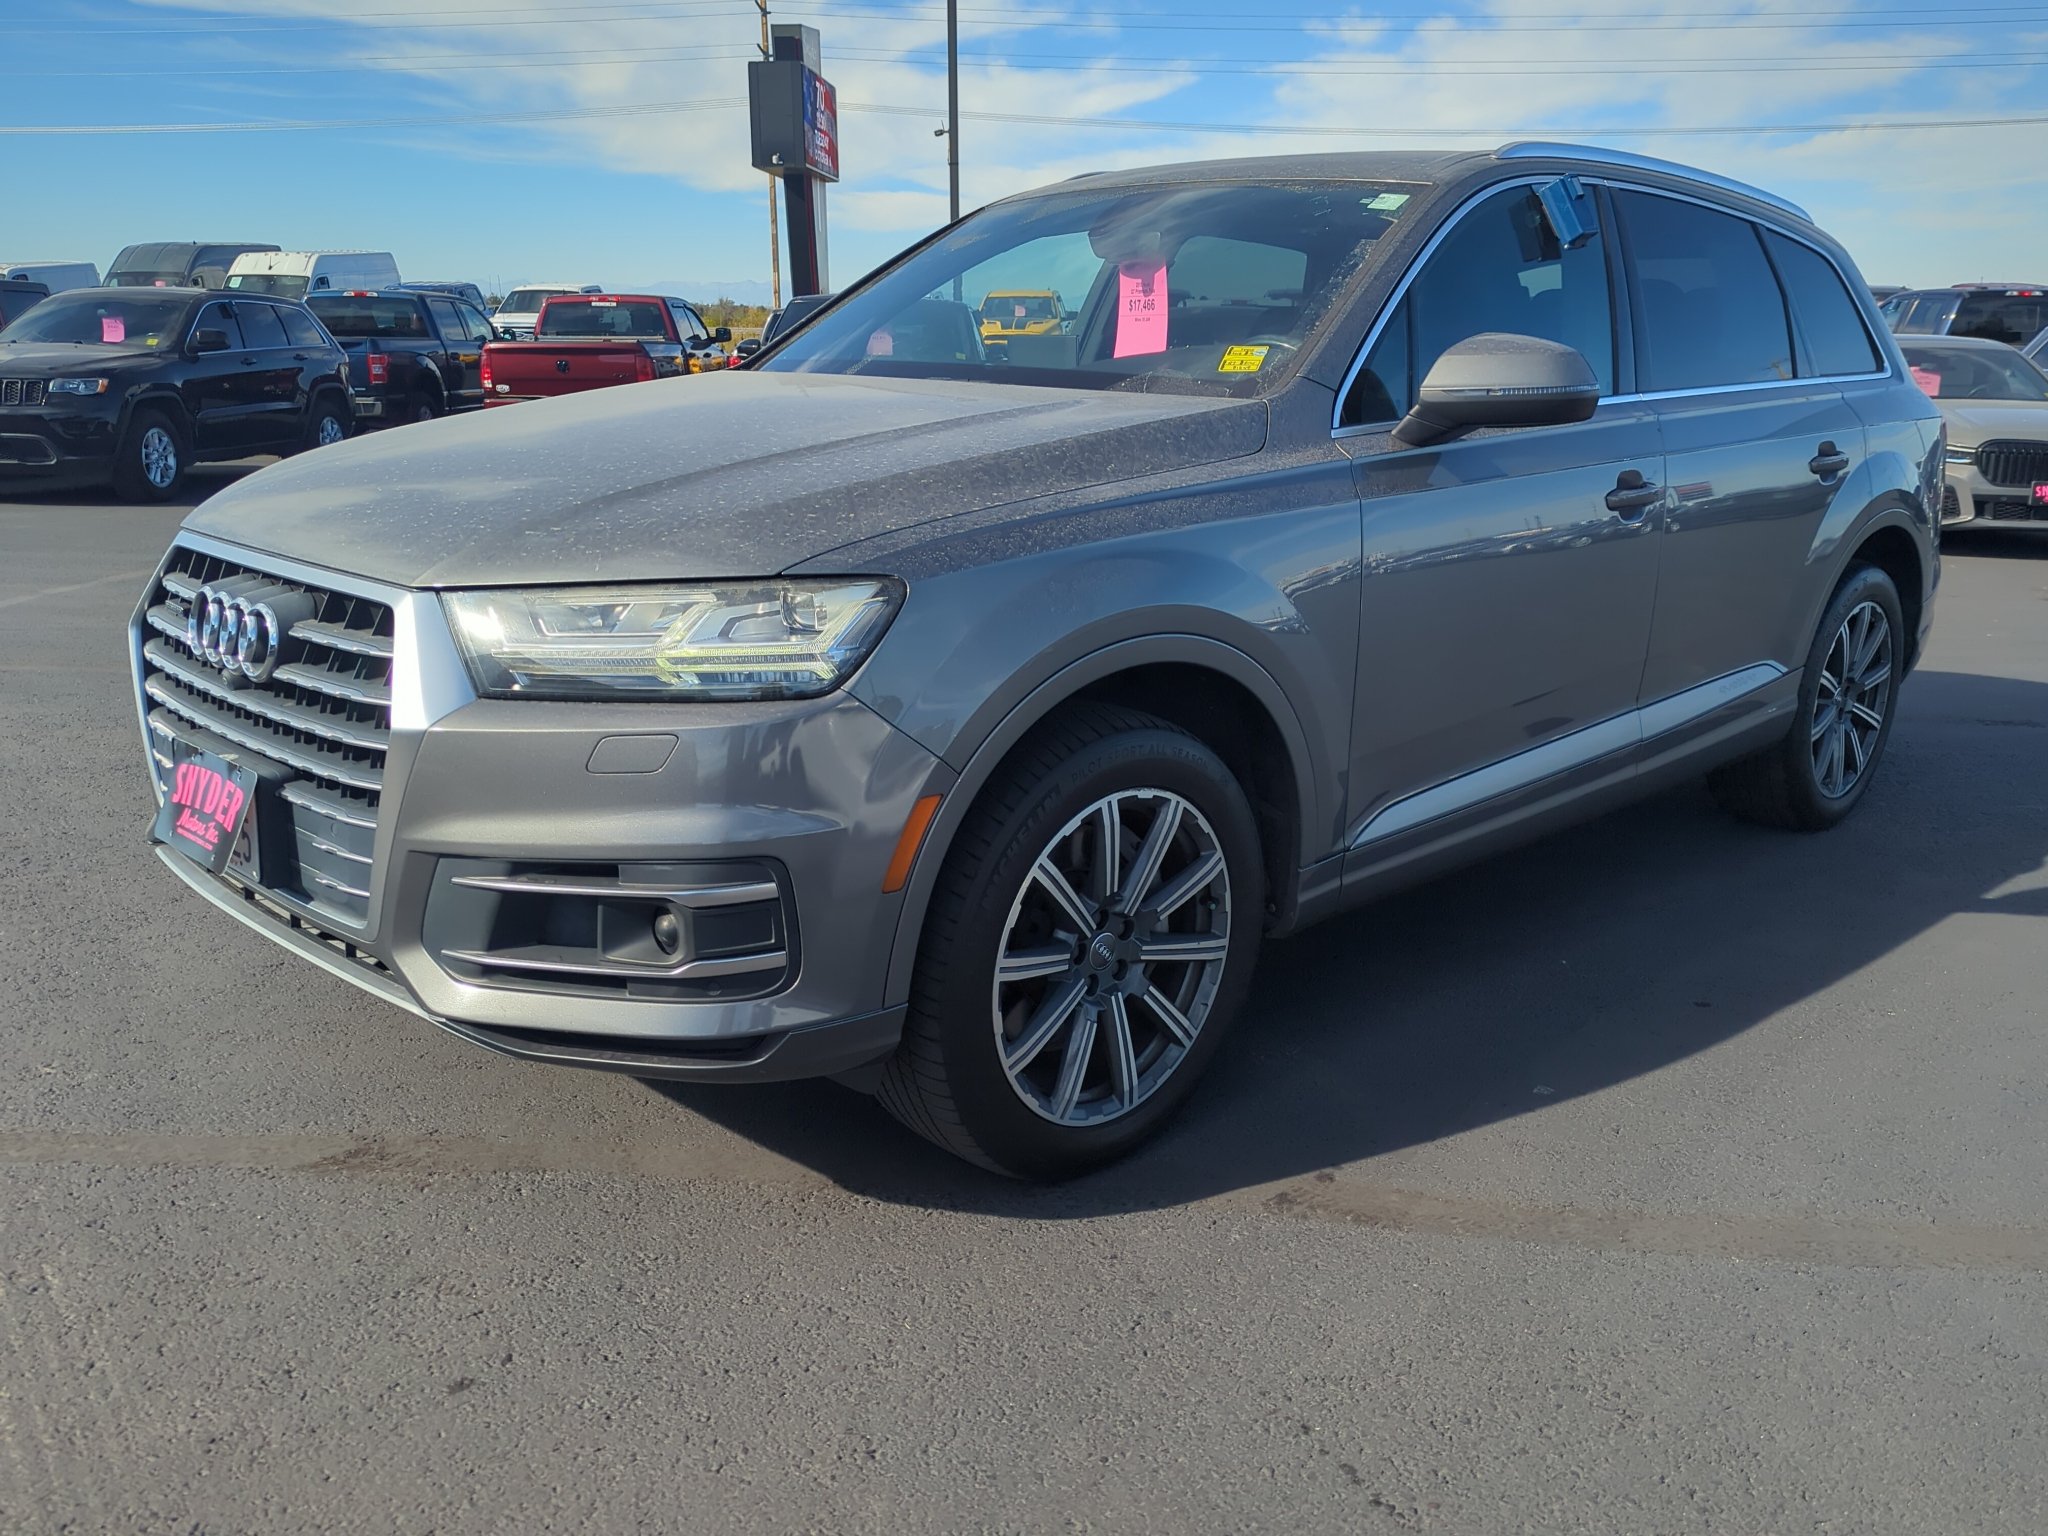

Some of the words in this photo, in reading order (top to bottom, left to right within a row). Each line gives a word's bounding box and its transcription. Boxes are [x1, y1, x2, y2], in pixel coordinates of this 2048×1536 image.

[1128, 298, 1156, 313] $17,466
[1145, 743, 1167, 756] ALL
[172, 763, 244, 832] SNYDER
